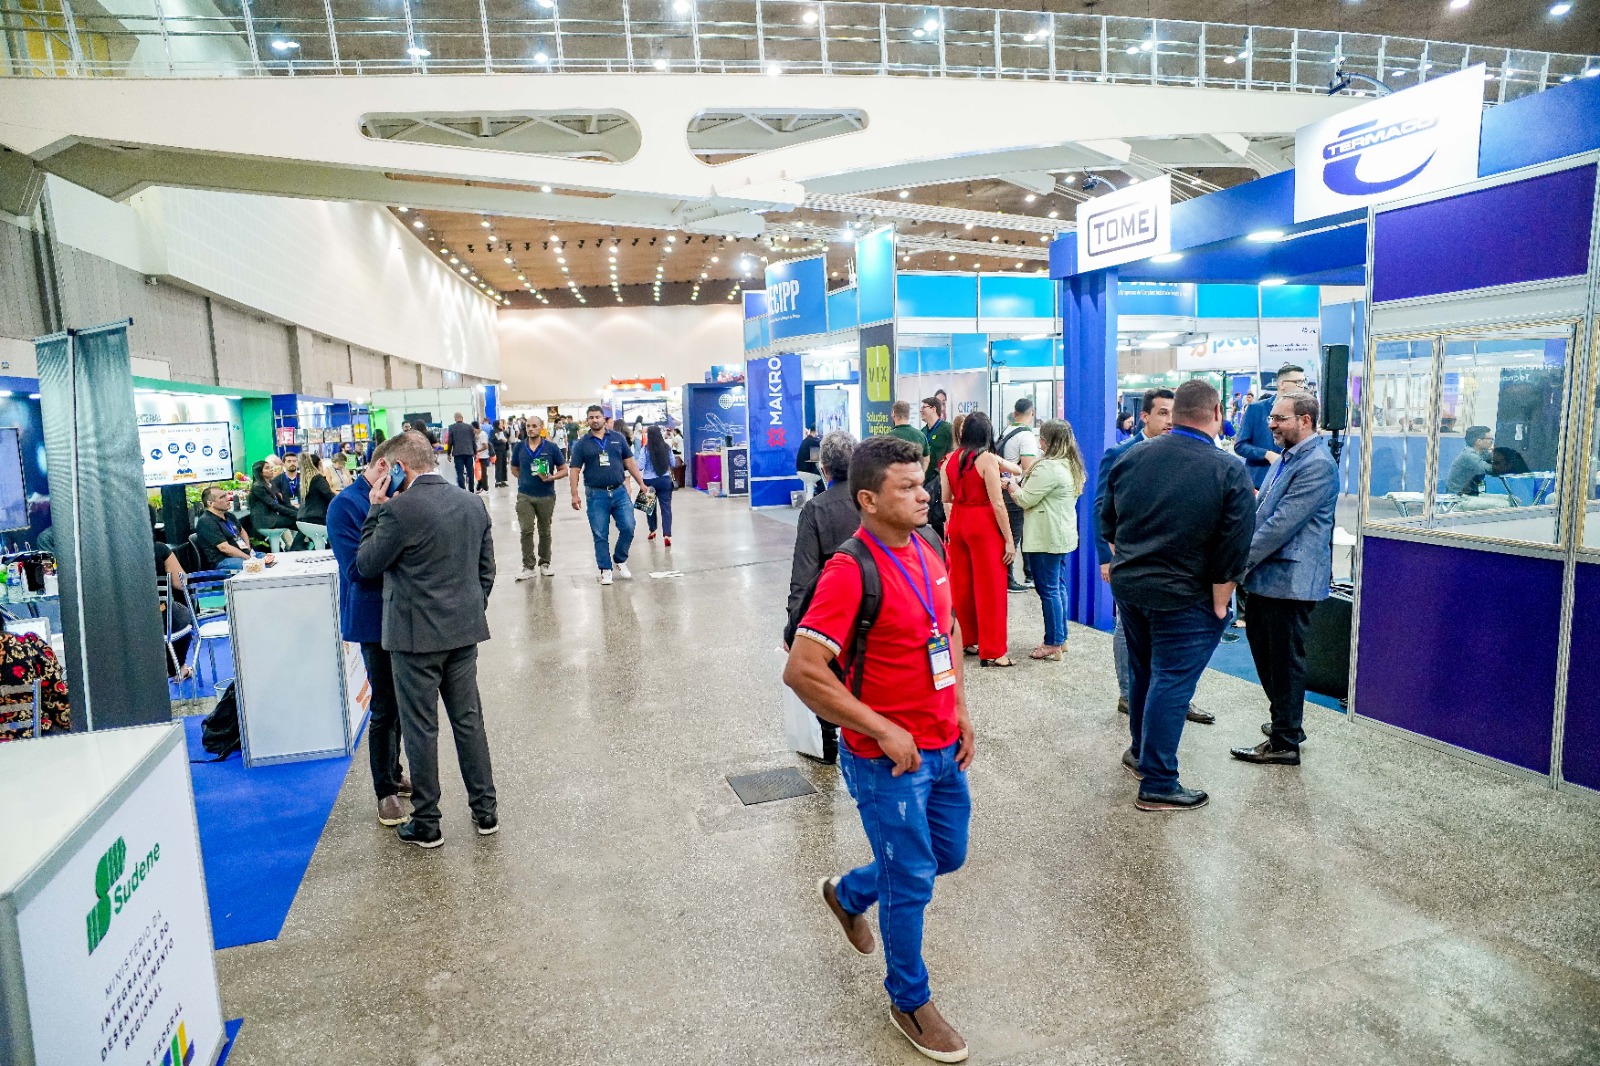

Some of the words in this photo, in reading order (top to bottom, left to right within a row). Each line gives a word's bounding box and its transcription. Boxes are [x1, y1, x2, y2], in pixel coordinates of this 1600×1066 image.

[1328, 118, 1436, 156] TERMACO
[1093, 209, 1149, 245] TOME
[767, 357, 783, 425] MAKRO
[868, 366, 887, 382] VIX
[114, 842, 160, 915] Sudene
[152, 909, 162, 928] DA
[153, 938, 158, 950] E
[160, 921, 169, 940] DO
[101, 937, 175, 1063] DESENVOLVIMENTO
[124, 982, 162, 1051] REGIONAL
[153, 1002, 183, 1060] FEDERAL
